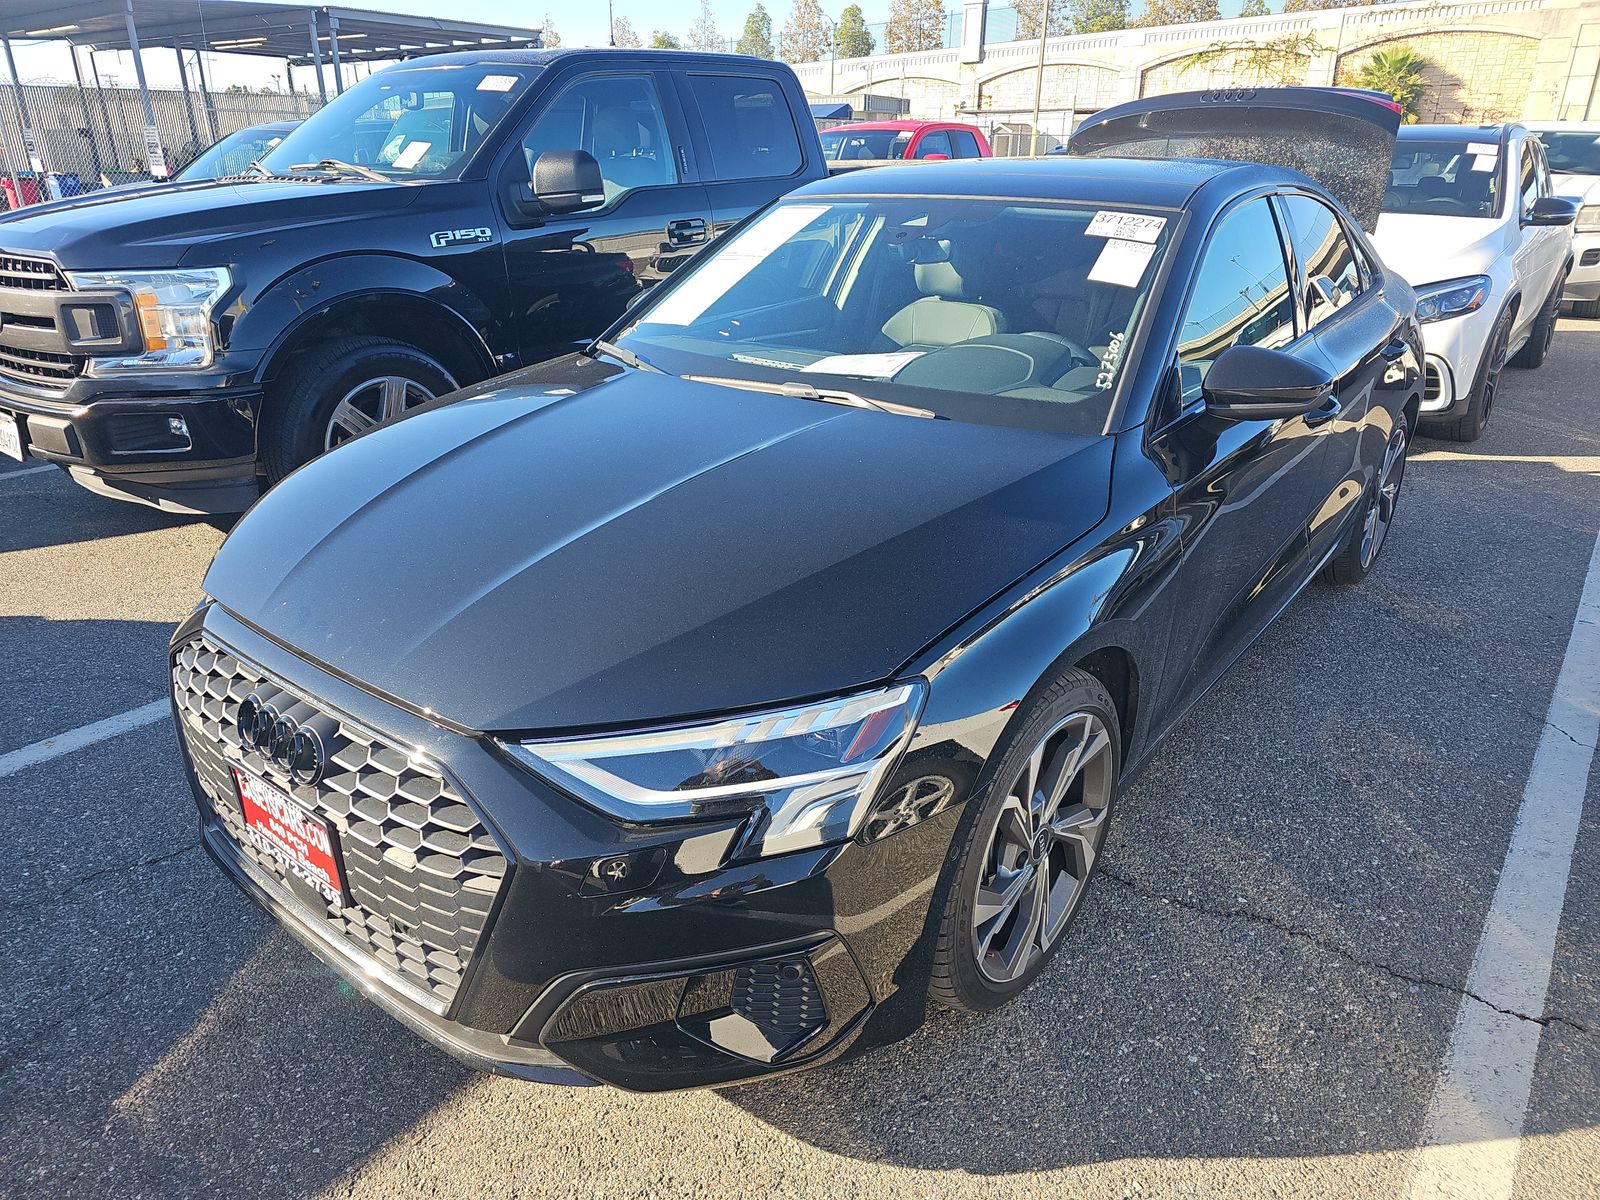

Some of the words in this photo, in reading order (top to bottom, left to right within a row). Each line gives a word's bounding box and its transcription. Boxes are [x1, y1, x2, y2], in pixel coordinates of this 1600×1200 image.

[1095, 214, 1163, 229] 3712274
[1096, 331, 1125, 390] 5275006
[286, 831, 309, 856] PCH
[297, 850, 331, 883] Beach
